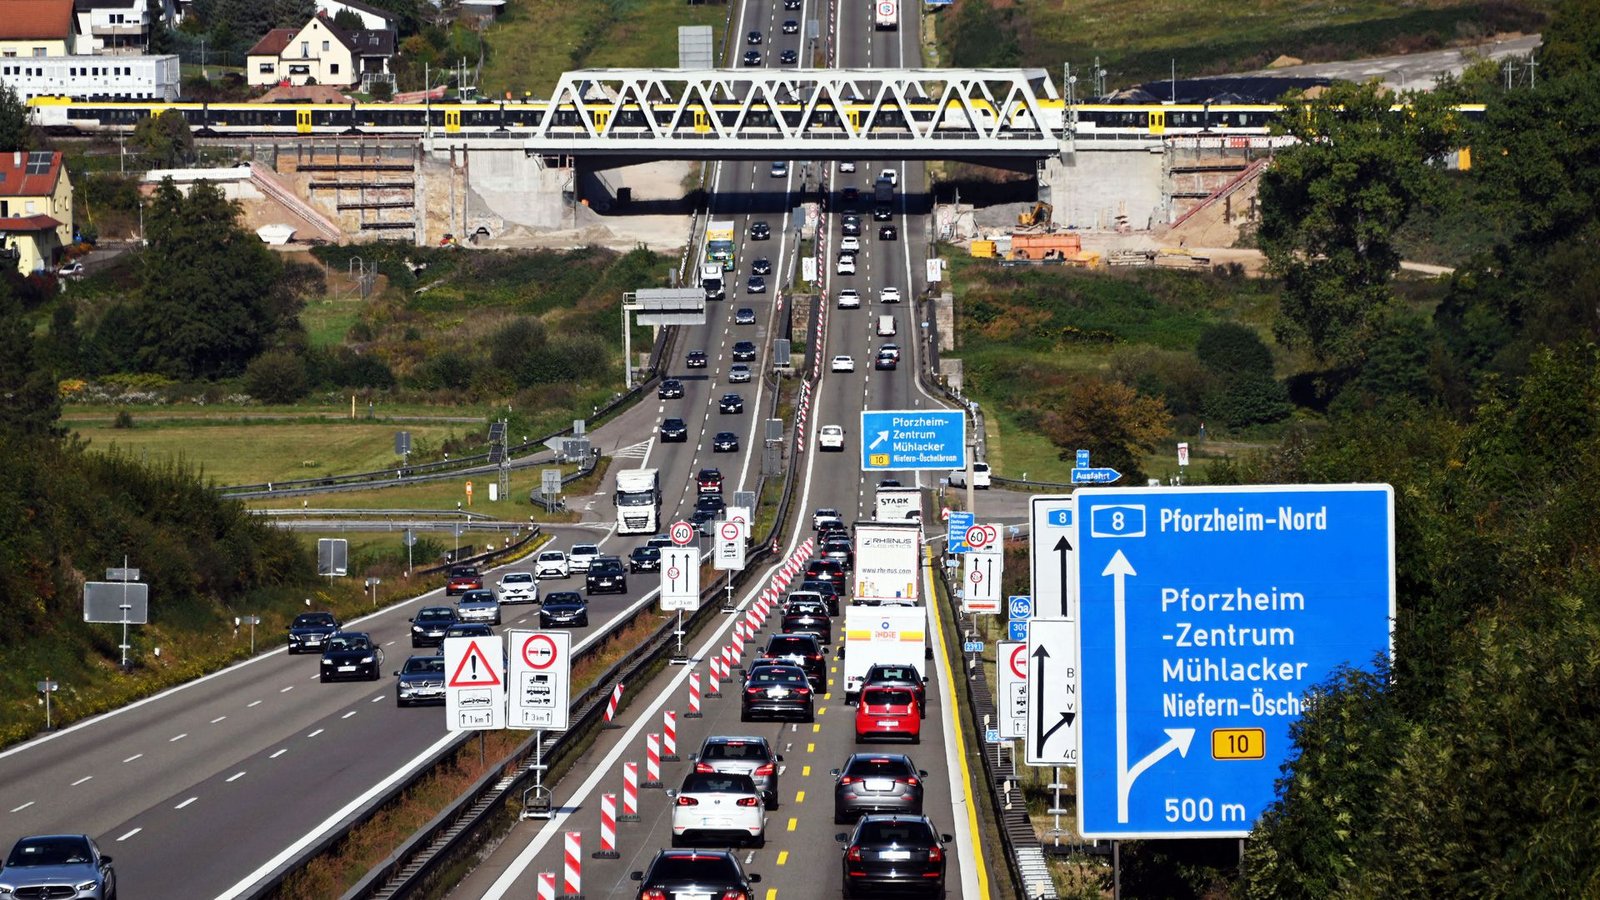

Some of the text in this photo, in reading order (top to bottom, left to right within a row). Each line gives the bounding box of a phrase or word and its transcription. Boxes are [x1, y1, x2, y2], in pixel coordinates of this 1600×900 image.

[892, 417, 949, 427] Pforzheim-
[893, 430, 936, 439] Zentrum
[893, 442, 945, 452] Mühlacker
[875, 456, 884, 464] 10
[893, 453, 957, 463] Niefern-Öschelbronn
[1076, 472, 1110, 480] Ausfahrt
[1058, 511, 1067, 523] 8
[1111, 506, 1327, 532] 8 Pforzheim-Nord
[675, 528, 688, 539] 60
[970, 531, 983, 542] 60
[1161, 587, 1305, 612] Pforzheim
[1012, 602, 1029, 614] 45a
[1162, 623, 1294, 647] -Zentrum
[1162, 657, 1308, 683] Mühlacker
[1227, 734, 1249, 754] 10
[1165, 797, 1246, 823] 500 m
